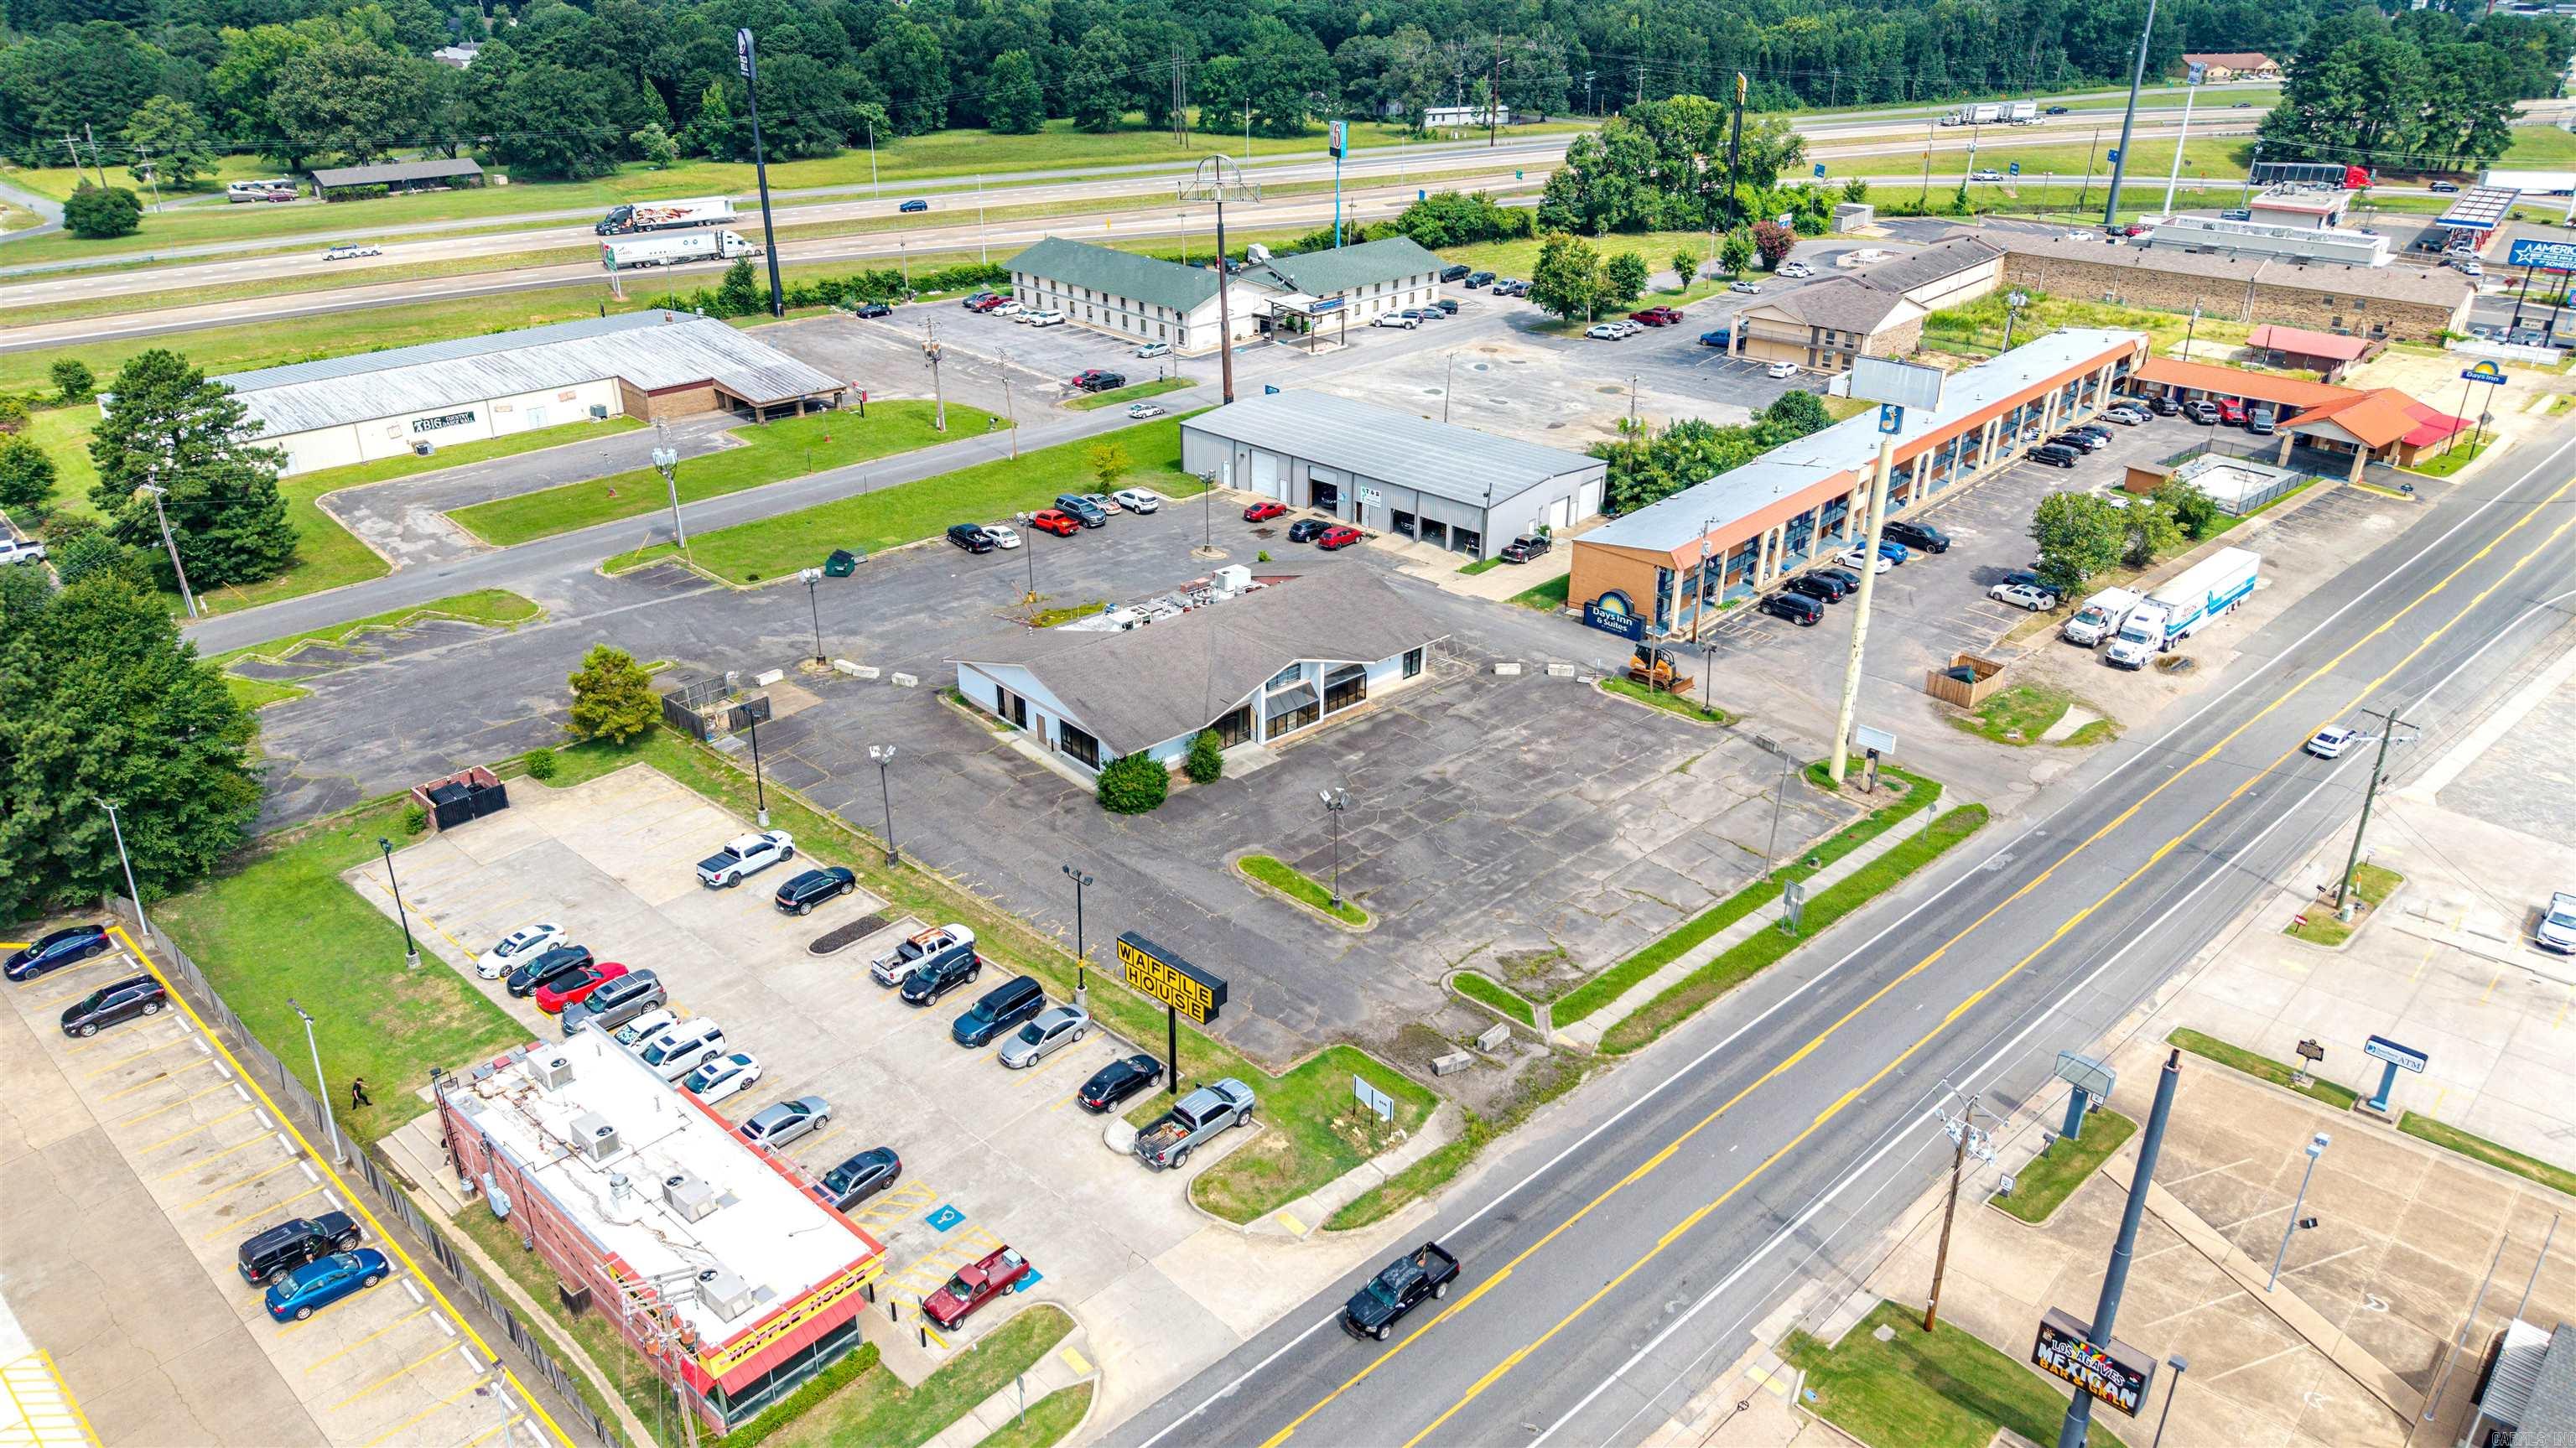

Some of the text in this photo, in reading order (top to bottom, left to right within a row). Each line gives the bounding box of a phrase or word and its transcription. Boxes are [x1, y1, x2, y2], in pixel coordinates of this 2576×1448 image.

[423, 418, 443, 430] BIG
[1592, 607, 1633, 626] Days Inn
[1603, 619, 1628, 631] Suites
[1119, 942, 1211, 1005] WAFFLE
[1129, 966, 1202, 1020] HOUSE
[2398, 1056, 2421, 1069] ATM
[2038, 1342, 2138, 1409] MEXICAN
[2039, 1358, 2128, 1409] BAR & GRILL
[2051, 1339, 2126, 1386] LOS AGAVES
